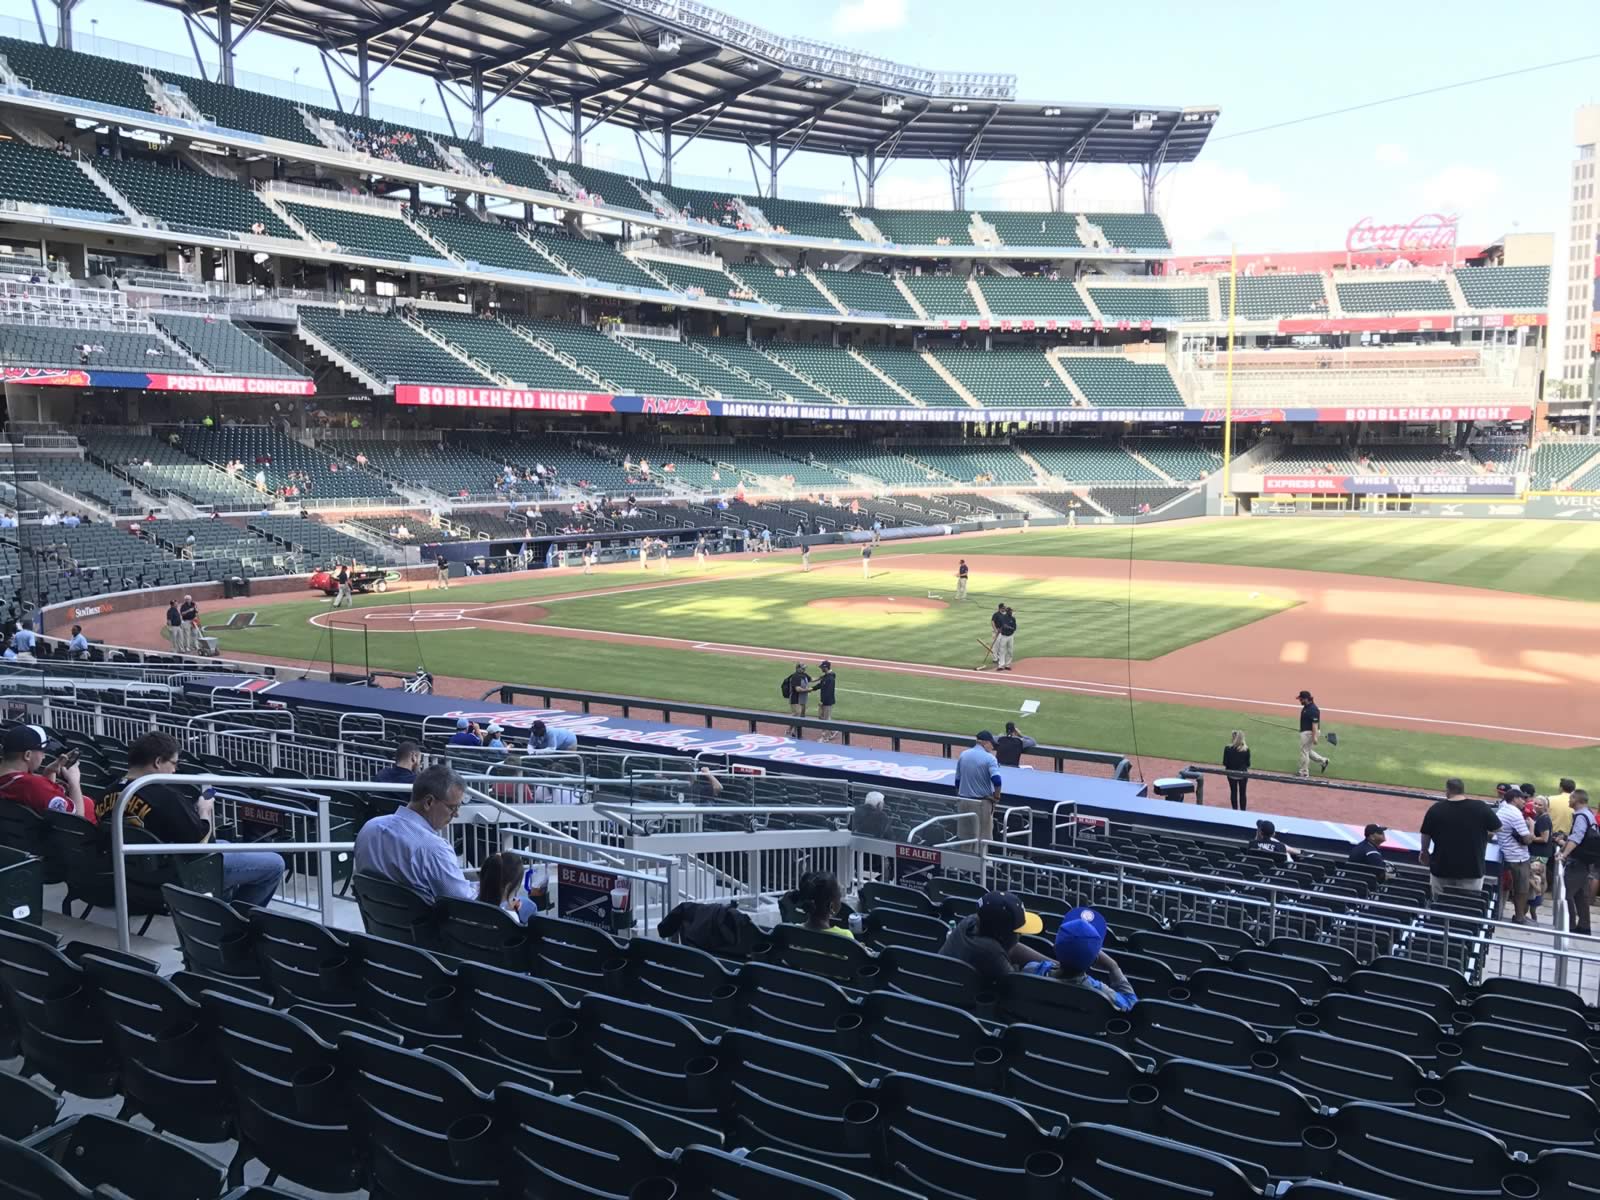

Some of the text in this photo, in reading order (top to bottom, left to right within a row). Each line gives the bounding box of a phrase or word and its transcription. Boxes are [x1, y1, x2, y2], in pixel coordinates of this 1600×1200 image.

[1457, 317, 1480, 327] 6:34
[167, 375, 307, 394] POSTGAME CONCERT
[418, 387, 587, 410] BOBBLEHEAD NIGHT
[722, 403, 1185, 421] BARTOLO COLON MAKES HIS WAY INTO SUNTRUST PARK WITH THIS ICONIC BOBBLEHEAD!
[1345, 407, 1510, 421] BOBBLEHEAD NIGHT
[1266, 479, 1336, 489] EXPRESS OIL
[1353, 476, 1389, 486] WHEN
[1392, 476, 1416, 485] THE
[1419, 476, 1466, 485] BRAVES
[1396, 485, 1467, 493] YOU SCORE!
[677, 733, 957, 781] Braves
[244, 806, 279, 824] BE ALERT
[900, 847, 937, 860] BE ALERT
[562, 868, 576, 882] BE
[578, 871, 611, 889] ALERT
